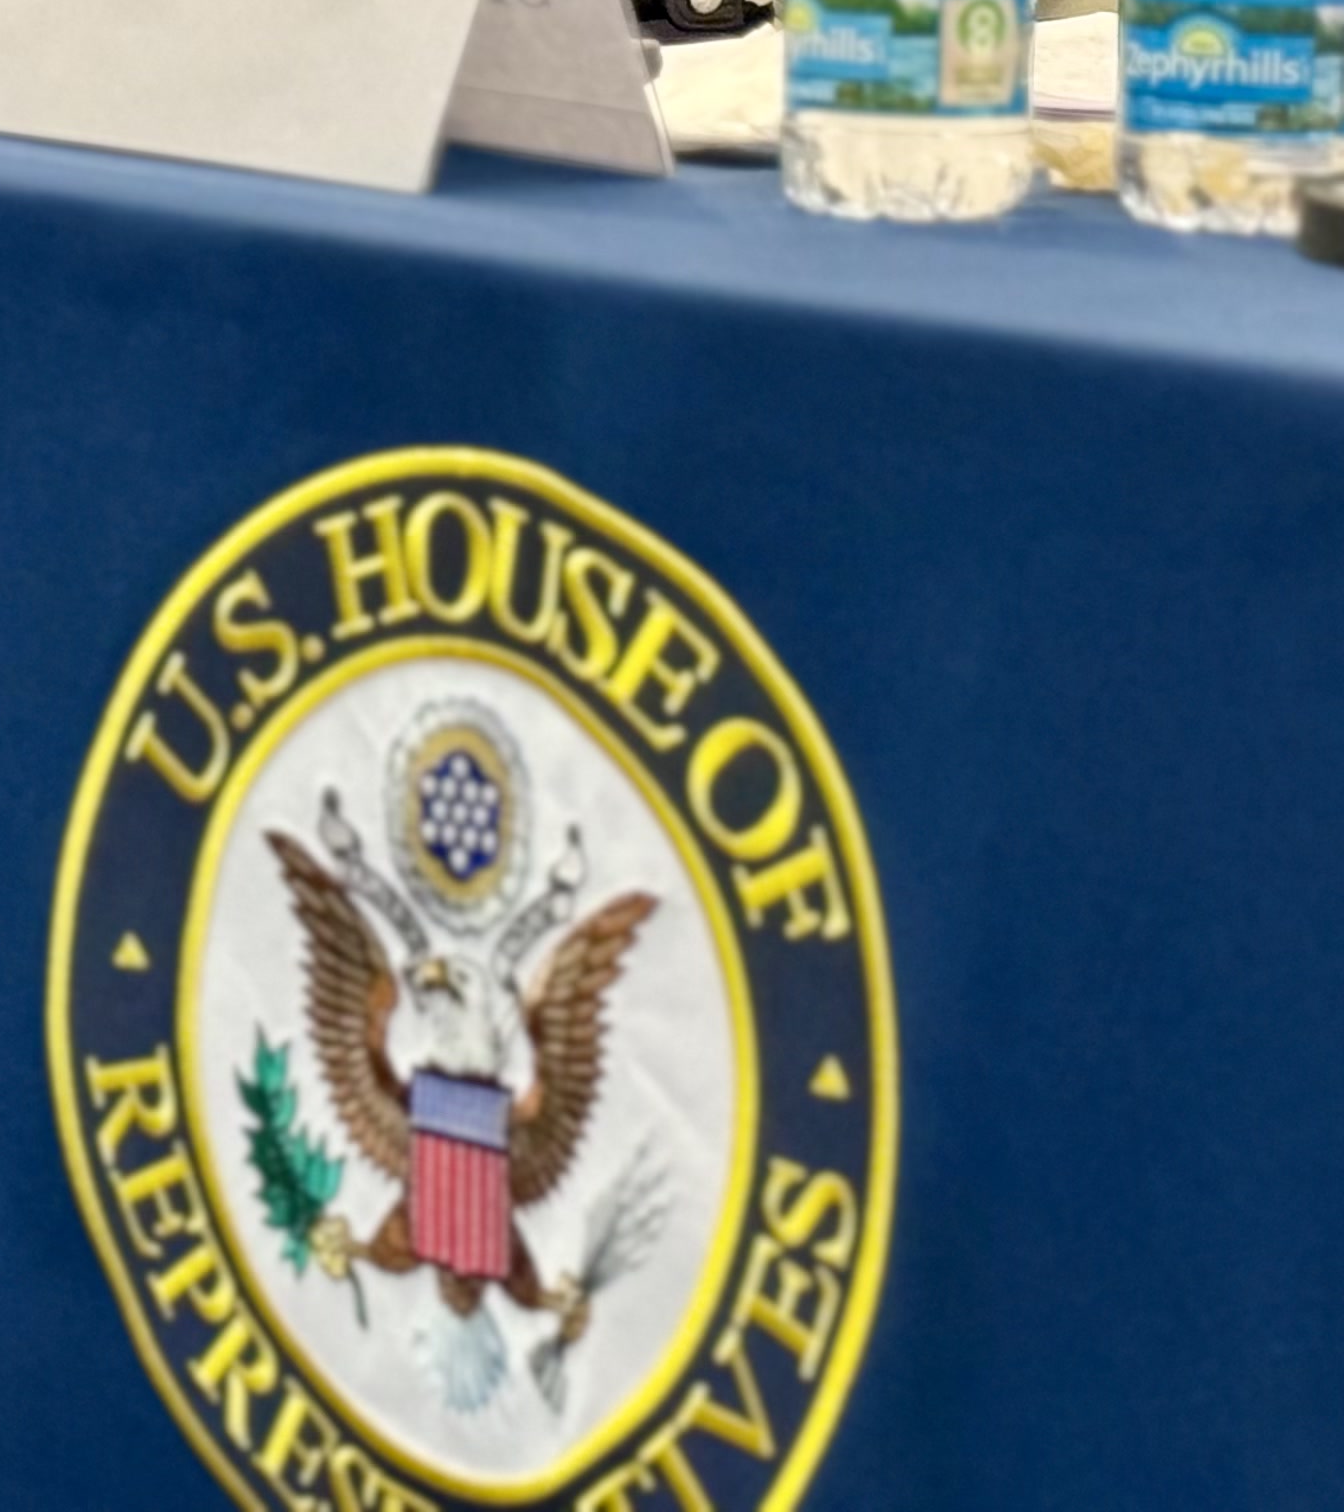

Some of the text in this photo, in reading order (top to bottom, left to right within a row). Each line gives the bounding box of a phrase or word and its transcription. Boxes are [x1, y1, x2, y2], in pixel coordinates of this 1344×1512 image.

[126, 491, 851, 941] U.S. HOUSE OF
